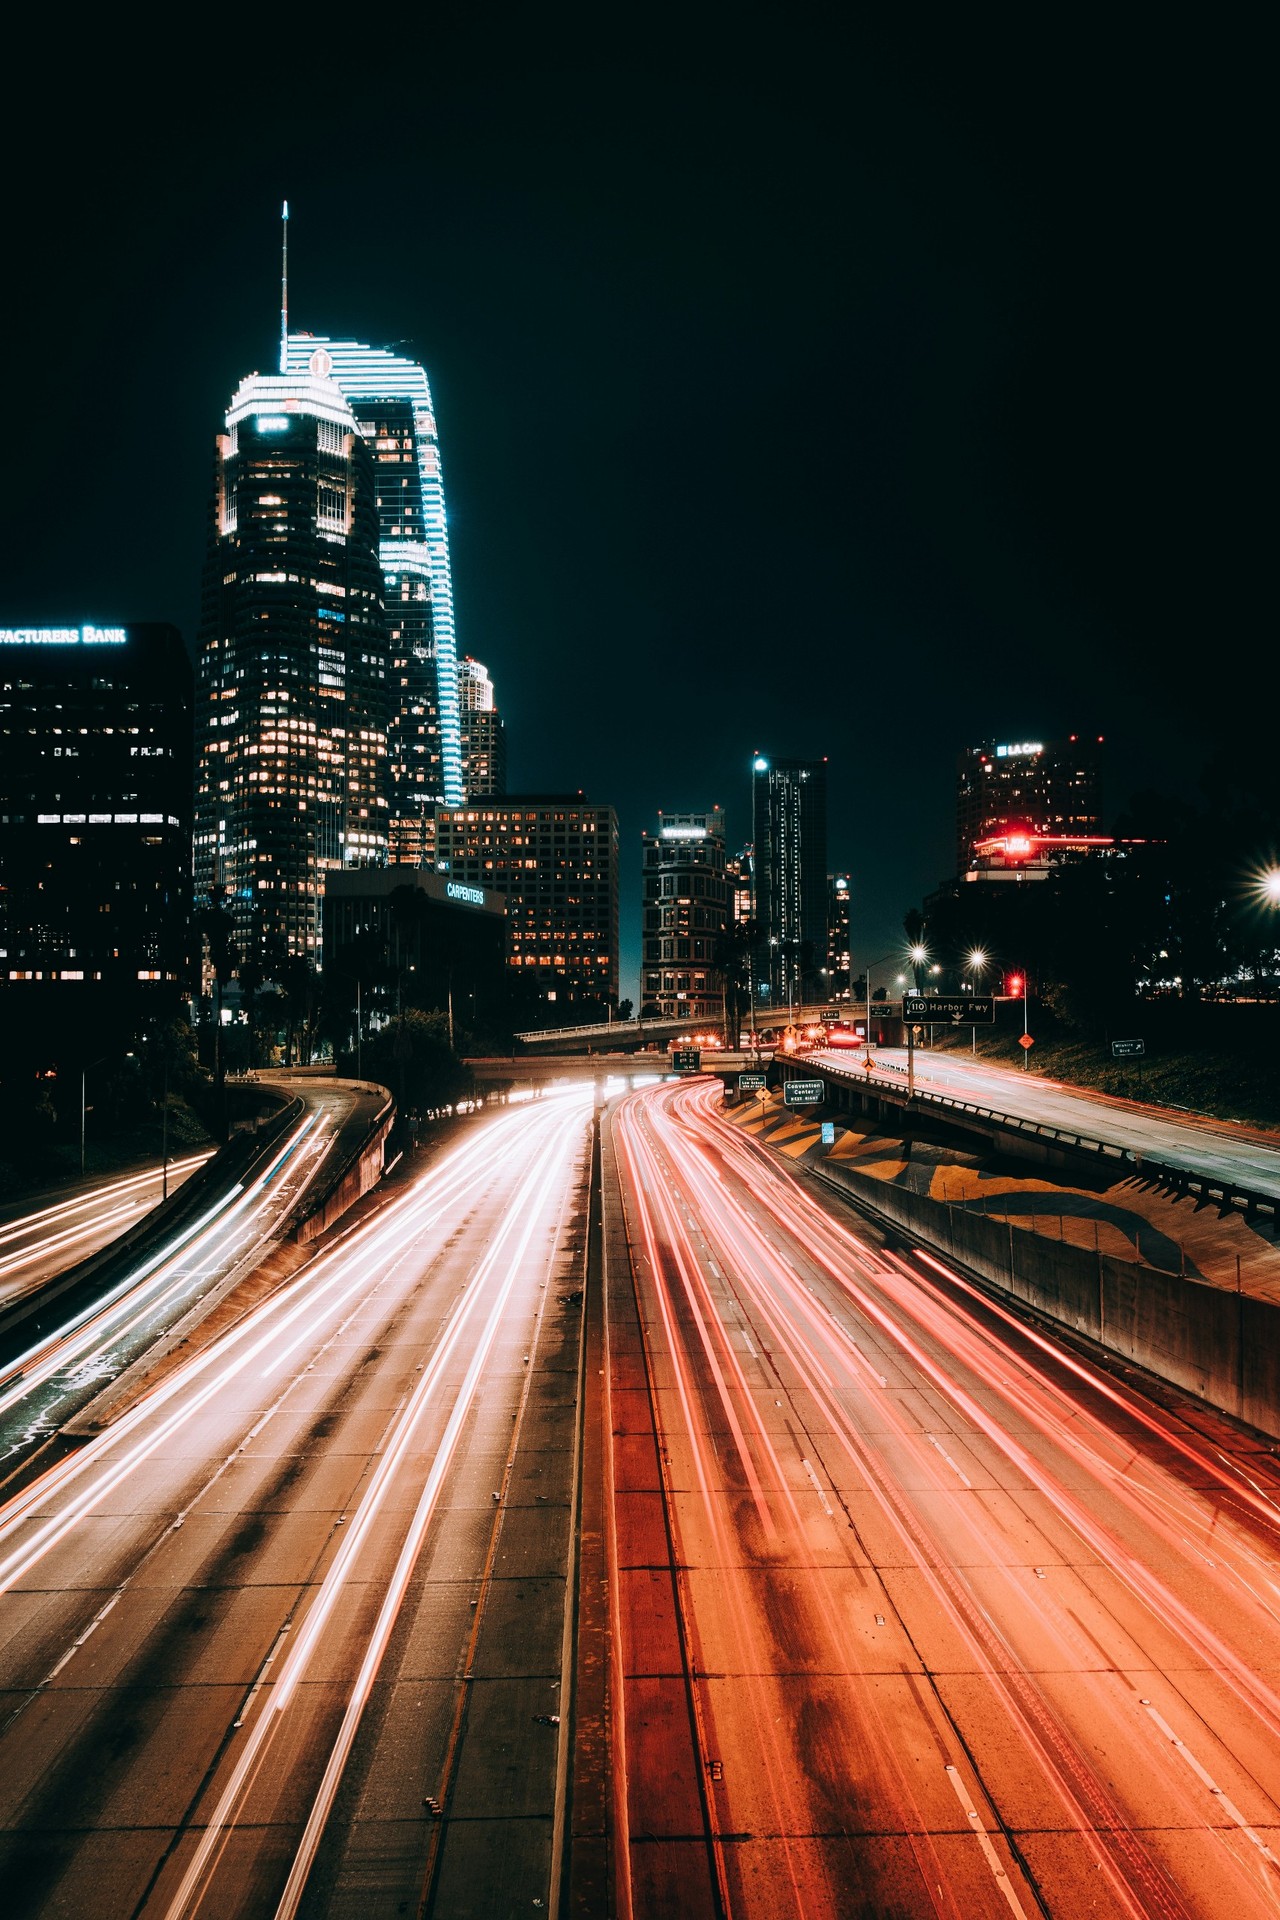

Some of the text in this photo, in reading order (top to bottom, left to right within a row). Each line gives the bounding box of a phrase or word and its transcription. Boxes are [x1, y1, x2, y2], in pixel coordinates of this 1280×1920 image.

[447, 882, 484, 904] CARPENTERS
[911, 1002, 988, 1013] 110 Harbor Fwy
